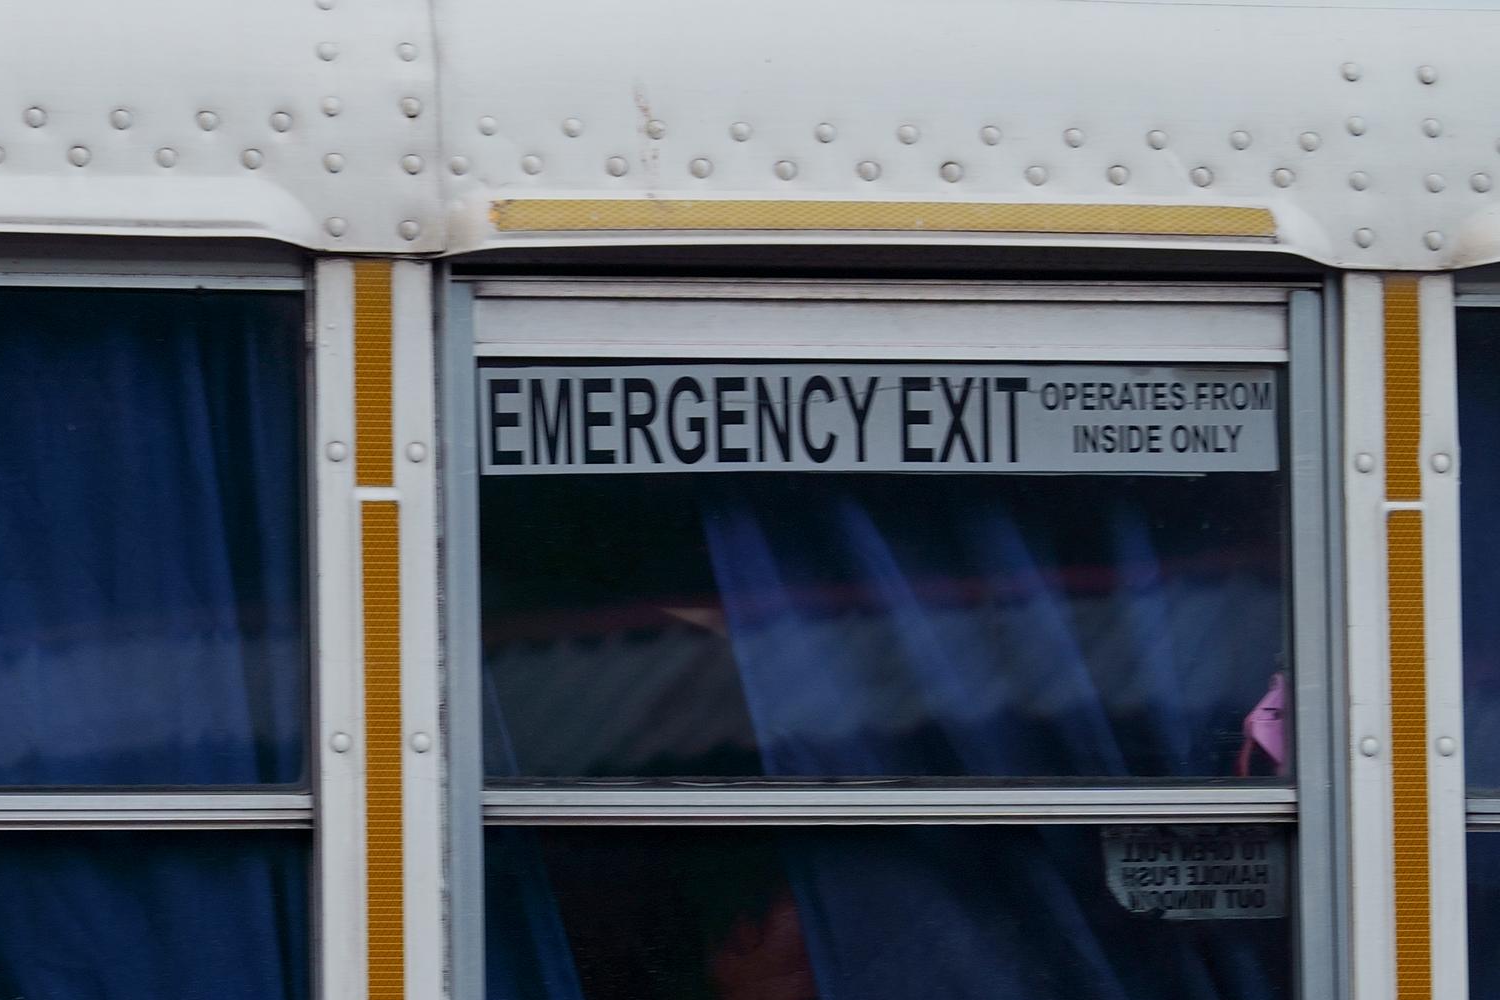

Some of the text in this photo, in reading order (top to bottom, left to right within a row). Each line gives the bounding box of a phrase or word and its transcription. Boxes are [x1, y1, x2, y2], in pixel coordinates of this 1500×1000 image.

[1040, 382, 1273, 411] OPERATES FROM
[487, 375, 1030, 466] EMERGENCY EXIT
[1073, 425, 1243, 454] INSIDE ONLY
